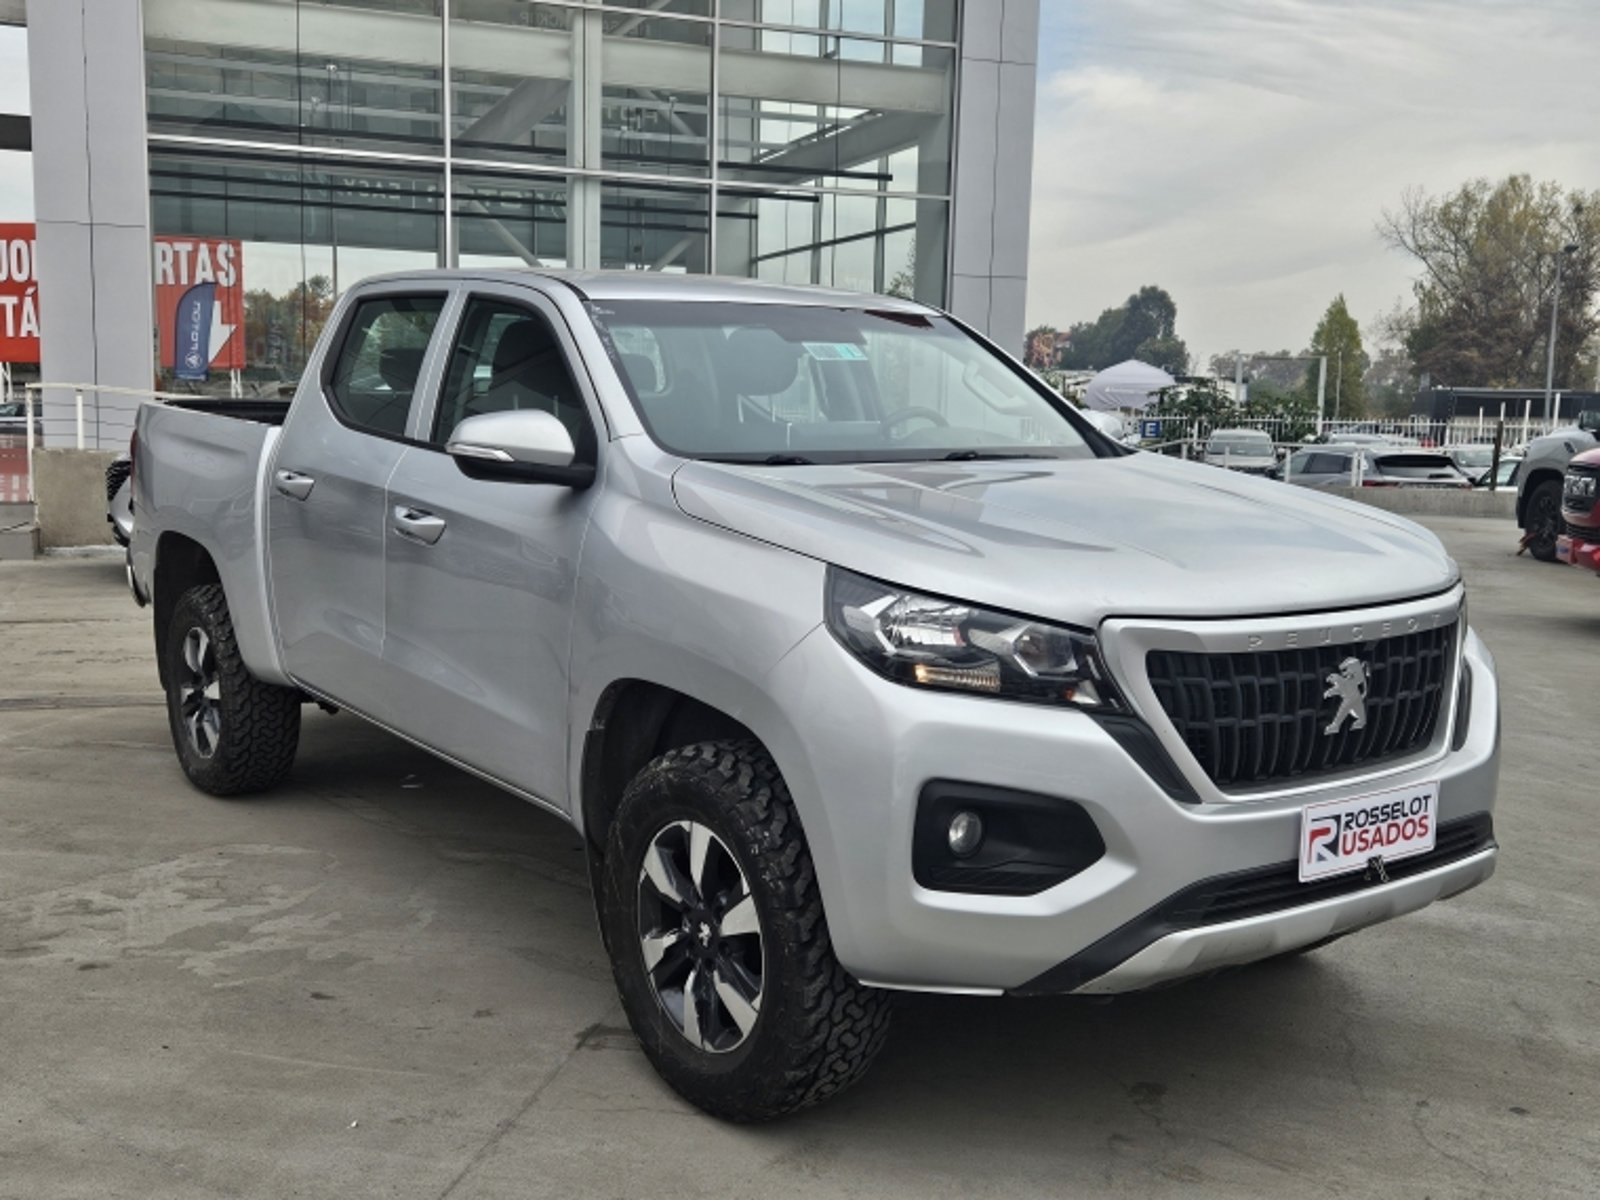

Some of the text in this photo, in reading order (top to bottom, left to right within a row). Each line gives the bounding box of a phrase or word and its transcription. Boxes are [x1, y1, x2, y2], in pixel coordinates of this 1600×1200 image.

[154, 241, 236, 287] RTAS
[1145, 422, 1157, 437] E
[1248, 613, 1442, 651] PEUGEOT
[1343, 795, 1431, 831] ROSSELOT
[1342, 815, 1429, 855] USADOS
